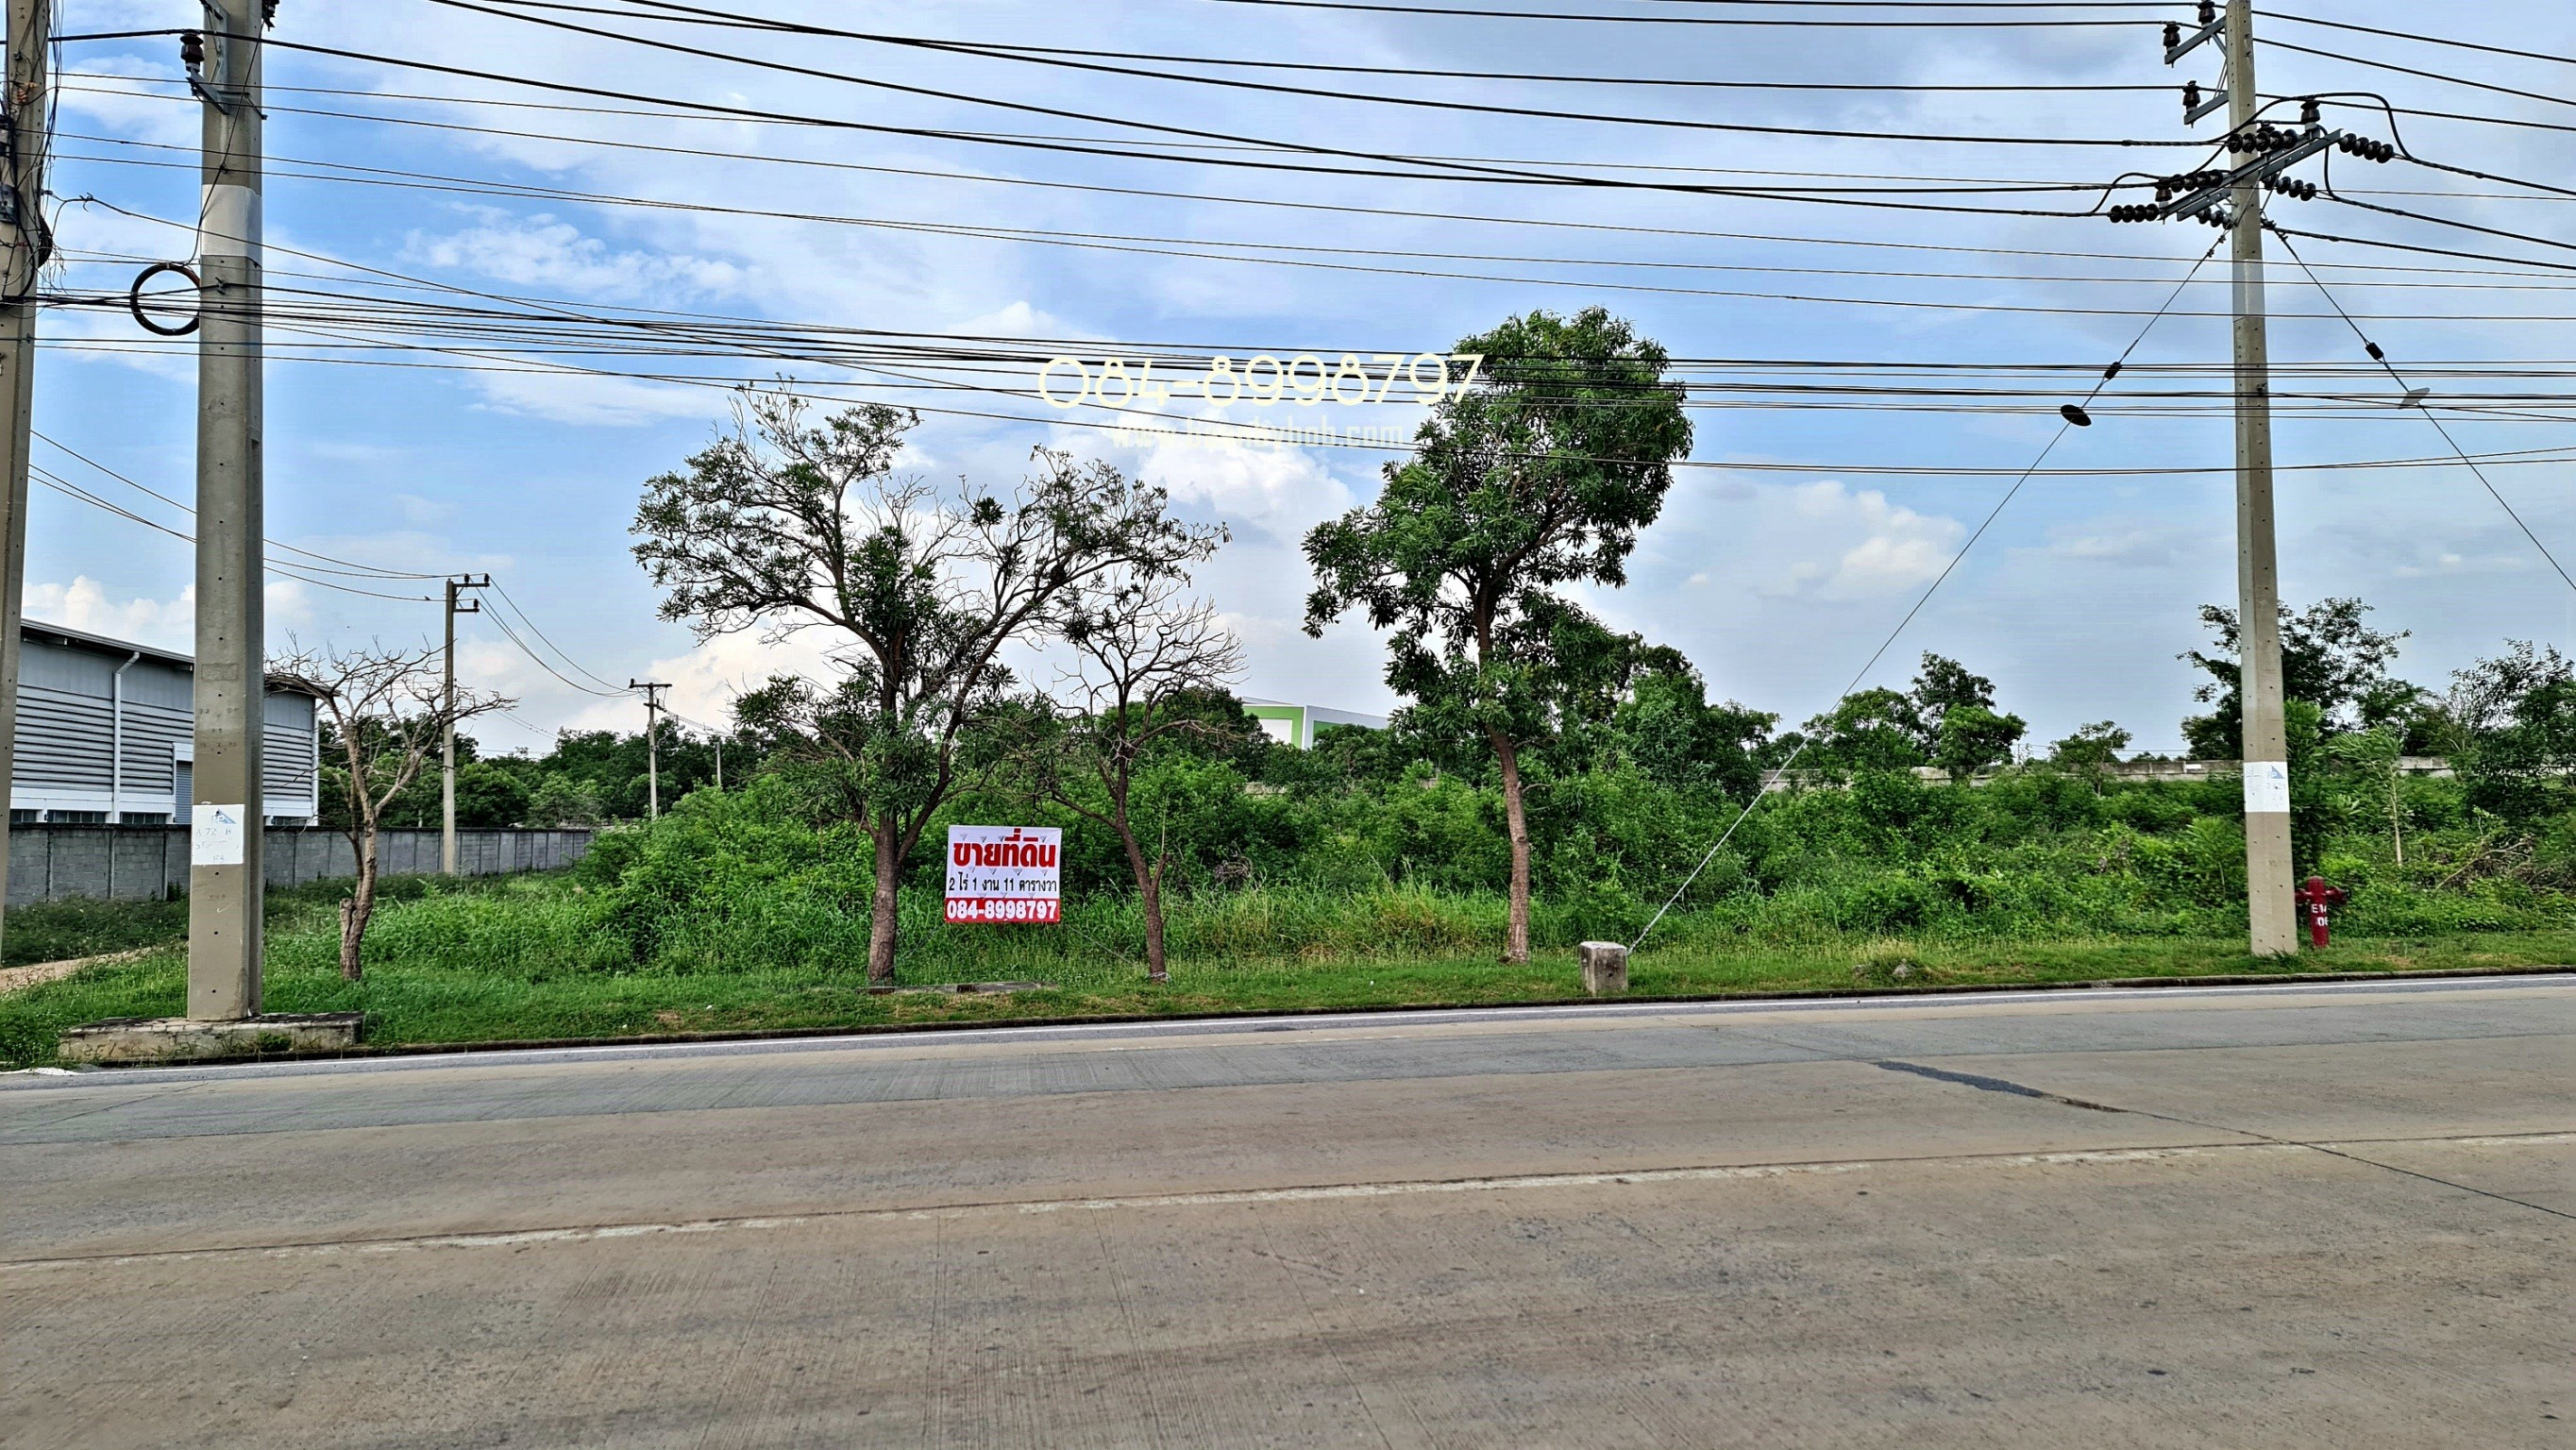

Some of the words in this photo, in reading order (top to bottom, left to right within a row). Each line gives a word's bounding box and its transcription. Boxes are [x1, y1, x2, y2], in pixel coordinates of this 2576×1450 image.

[953, 828, 1055, 867] ขายที่ดิน
[949, 877, 954, 890] 2
[958, 871, 968, 890] ไร่
[972, 877, 976, 890] 1
[982, 878, 999, 890] งาน
[1003, 877, 1014, 890] 11
[947, 900, 1056, 919] 084-8998797
